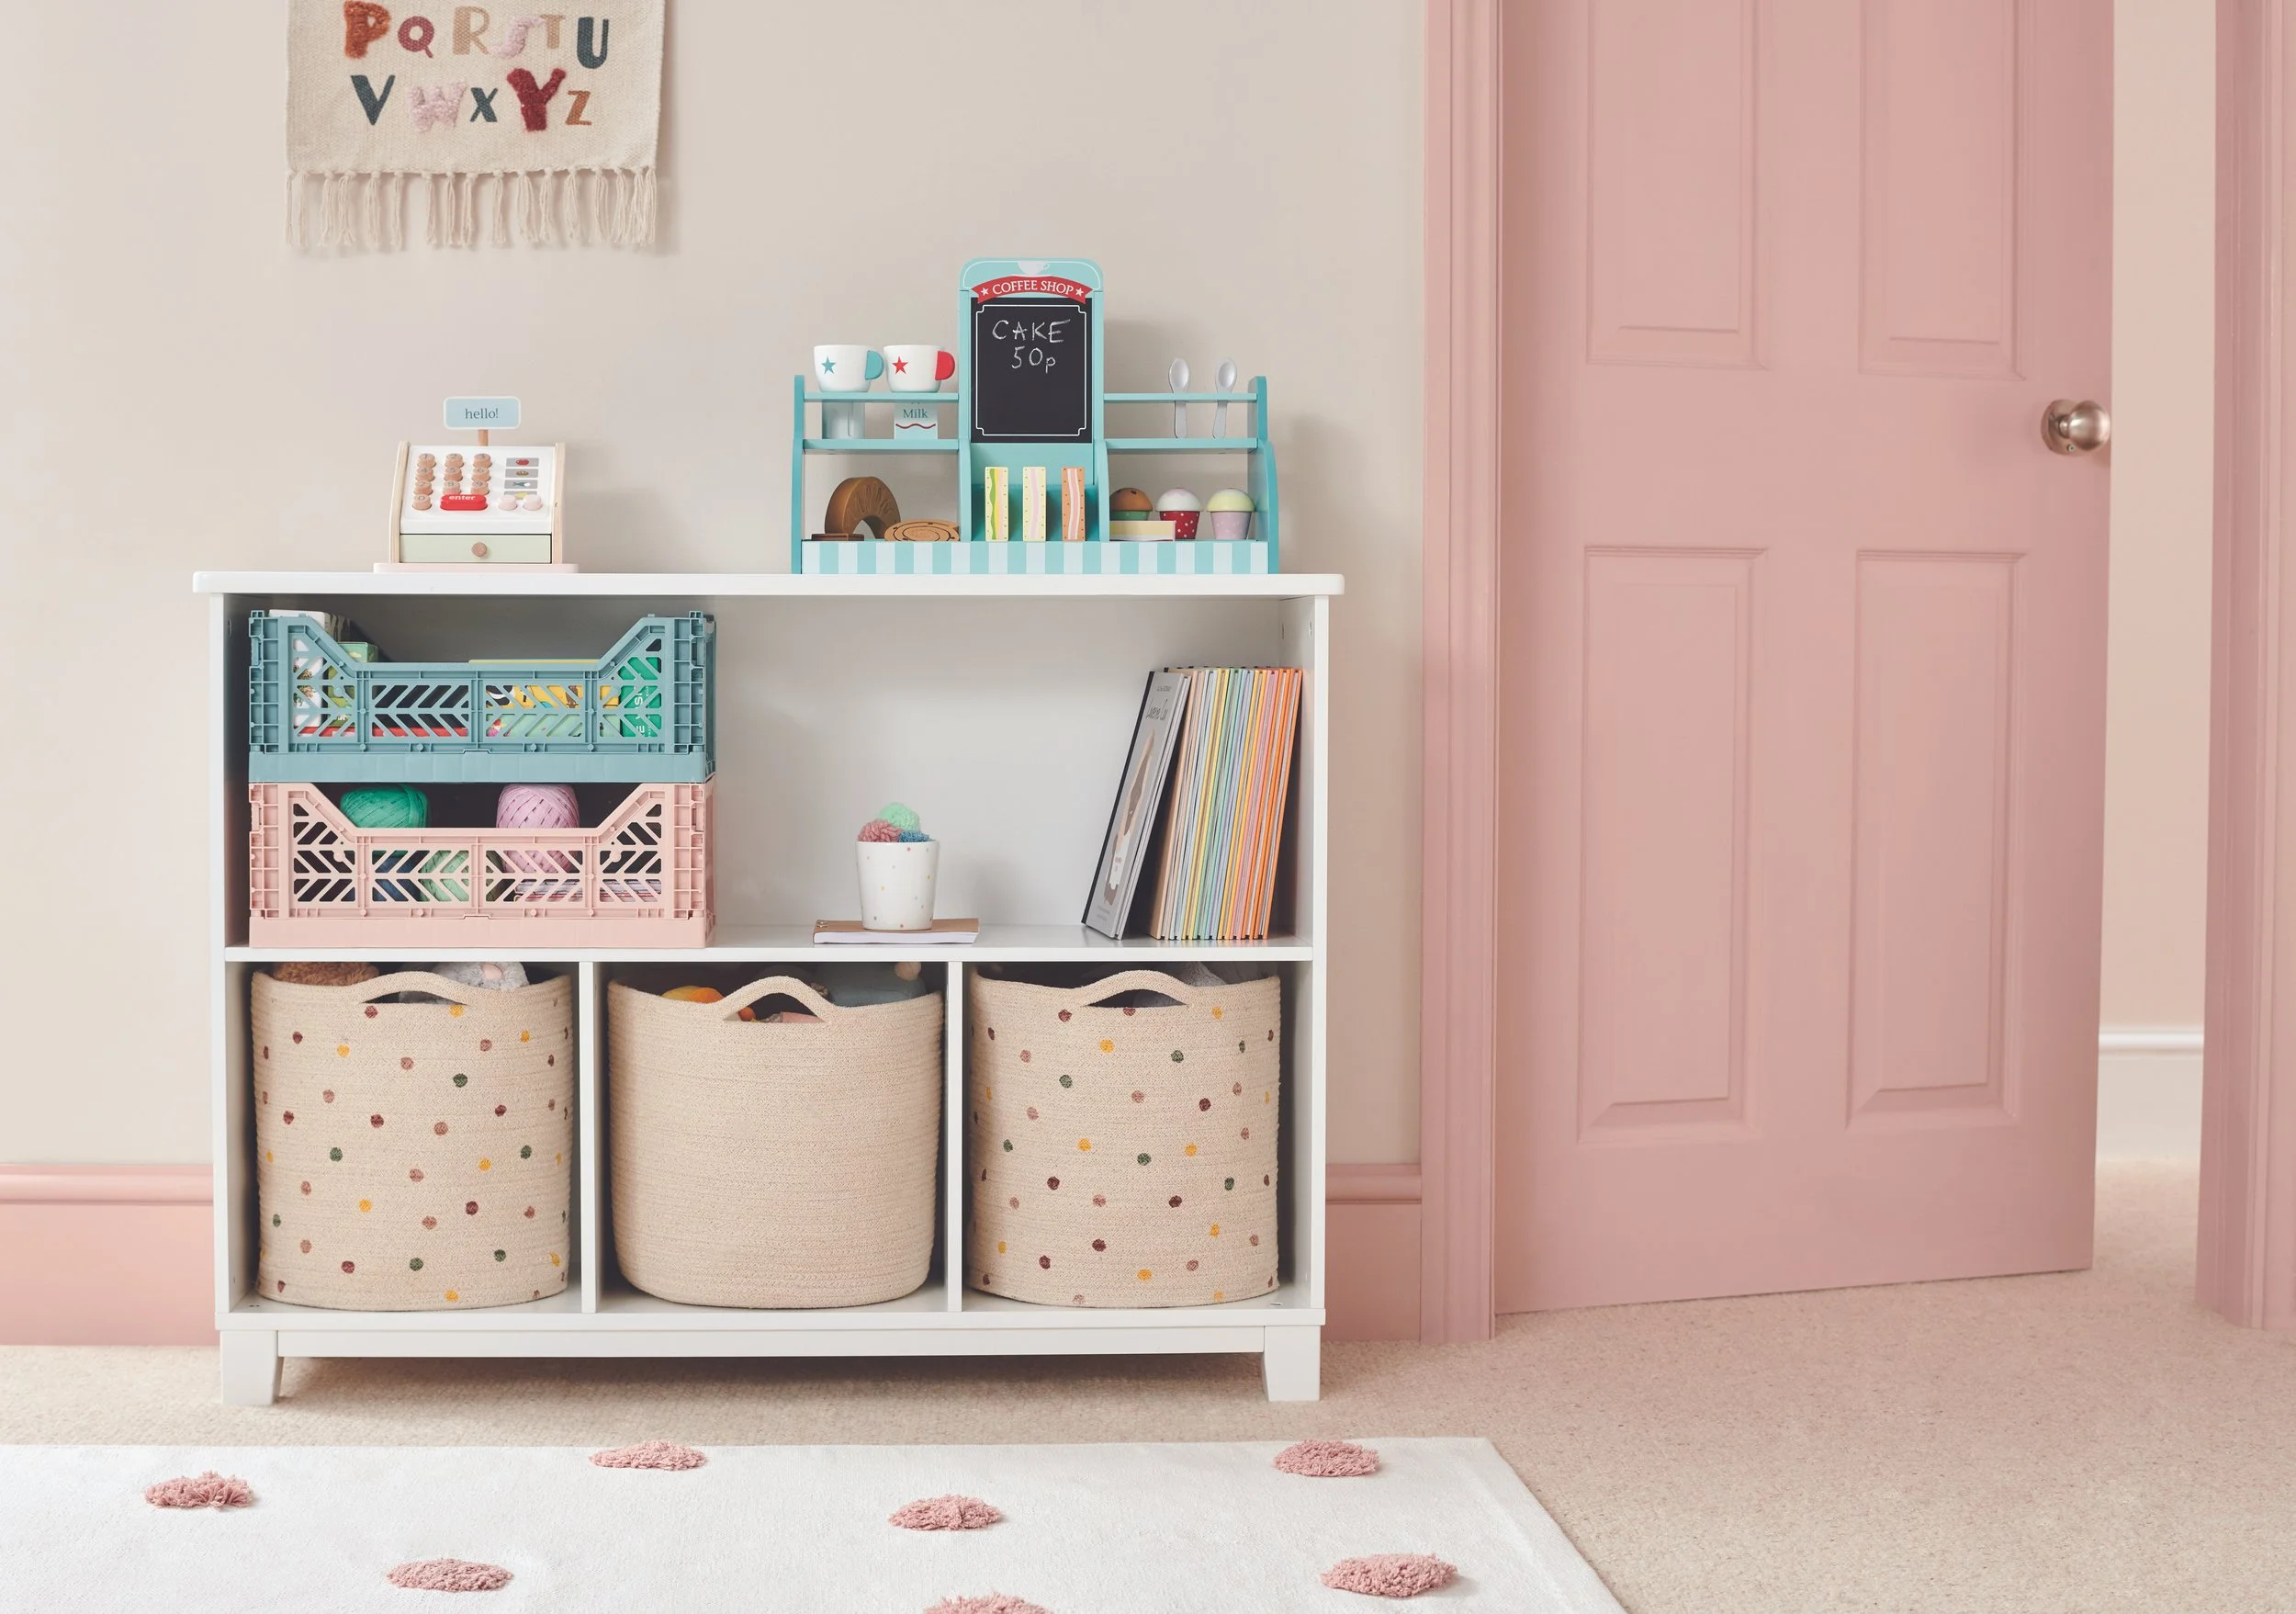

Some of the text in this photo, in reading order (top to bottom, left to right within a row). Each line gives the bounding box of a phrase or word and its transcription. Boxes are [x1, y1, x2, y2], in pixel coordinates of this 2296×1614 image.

[992, 279, 1075, 296] COFFEE SHOP
[992, 319, 1071, 344] CAKE
[1011, 345, 1056, 374] 50p
[465, 408, 499, 419] hello!
[903, 408, 929, 419] Milk
